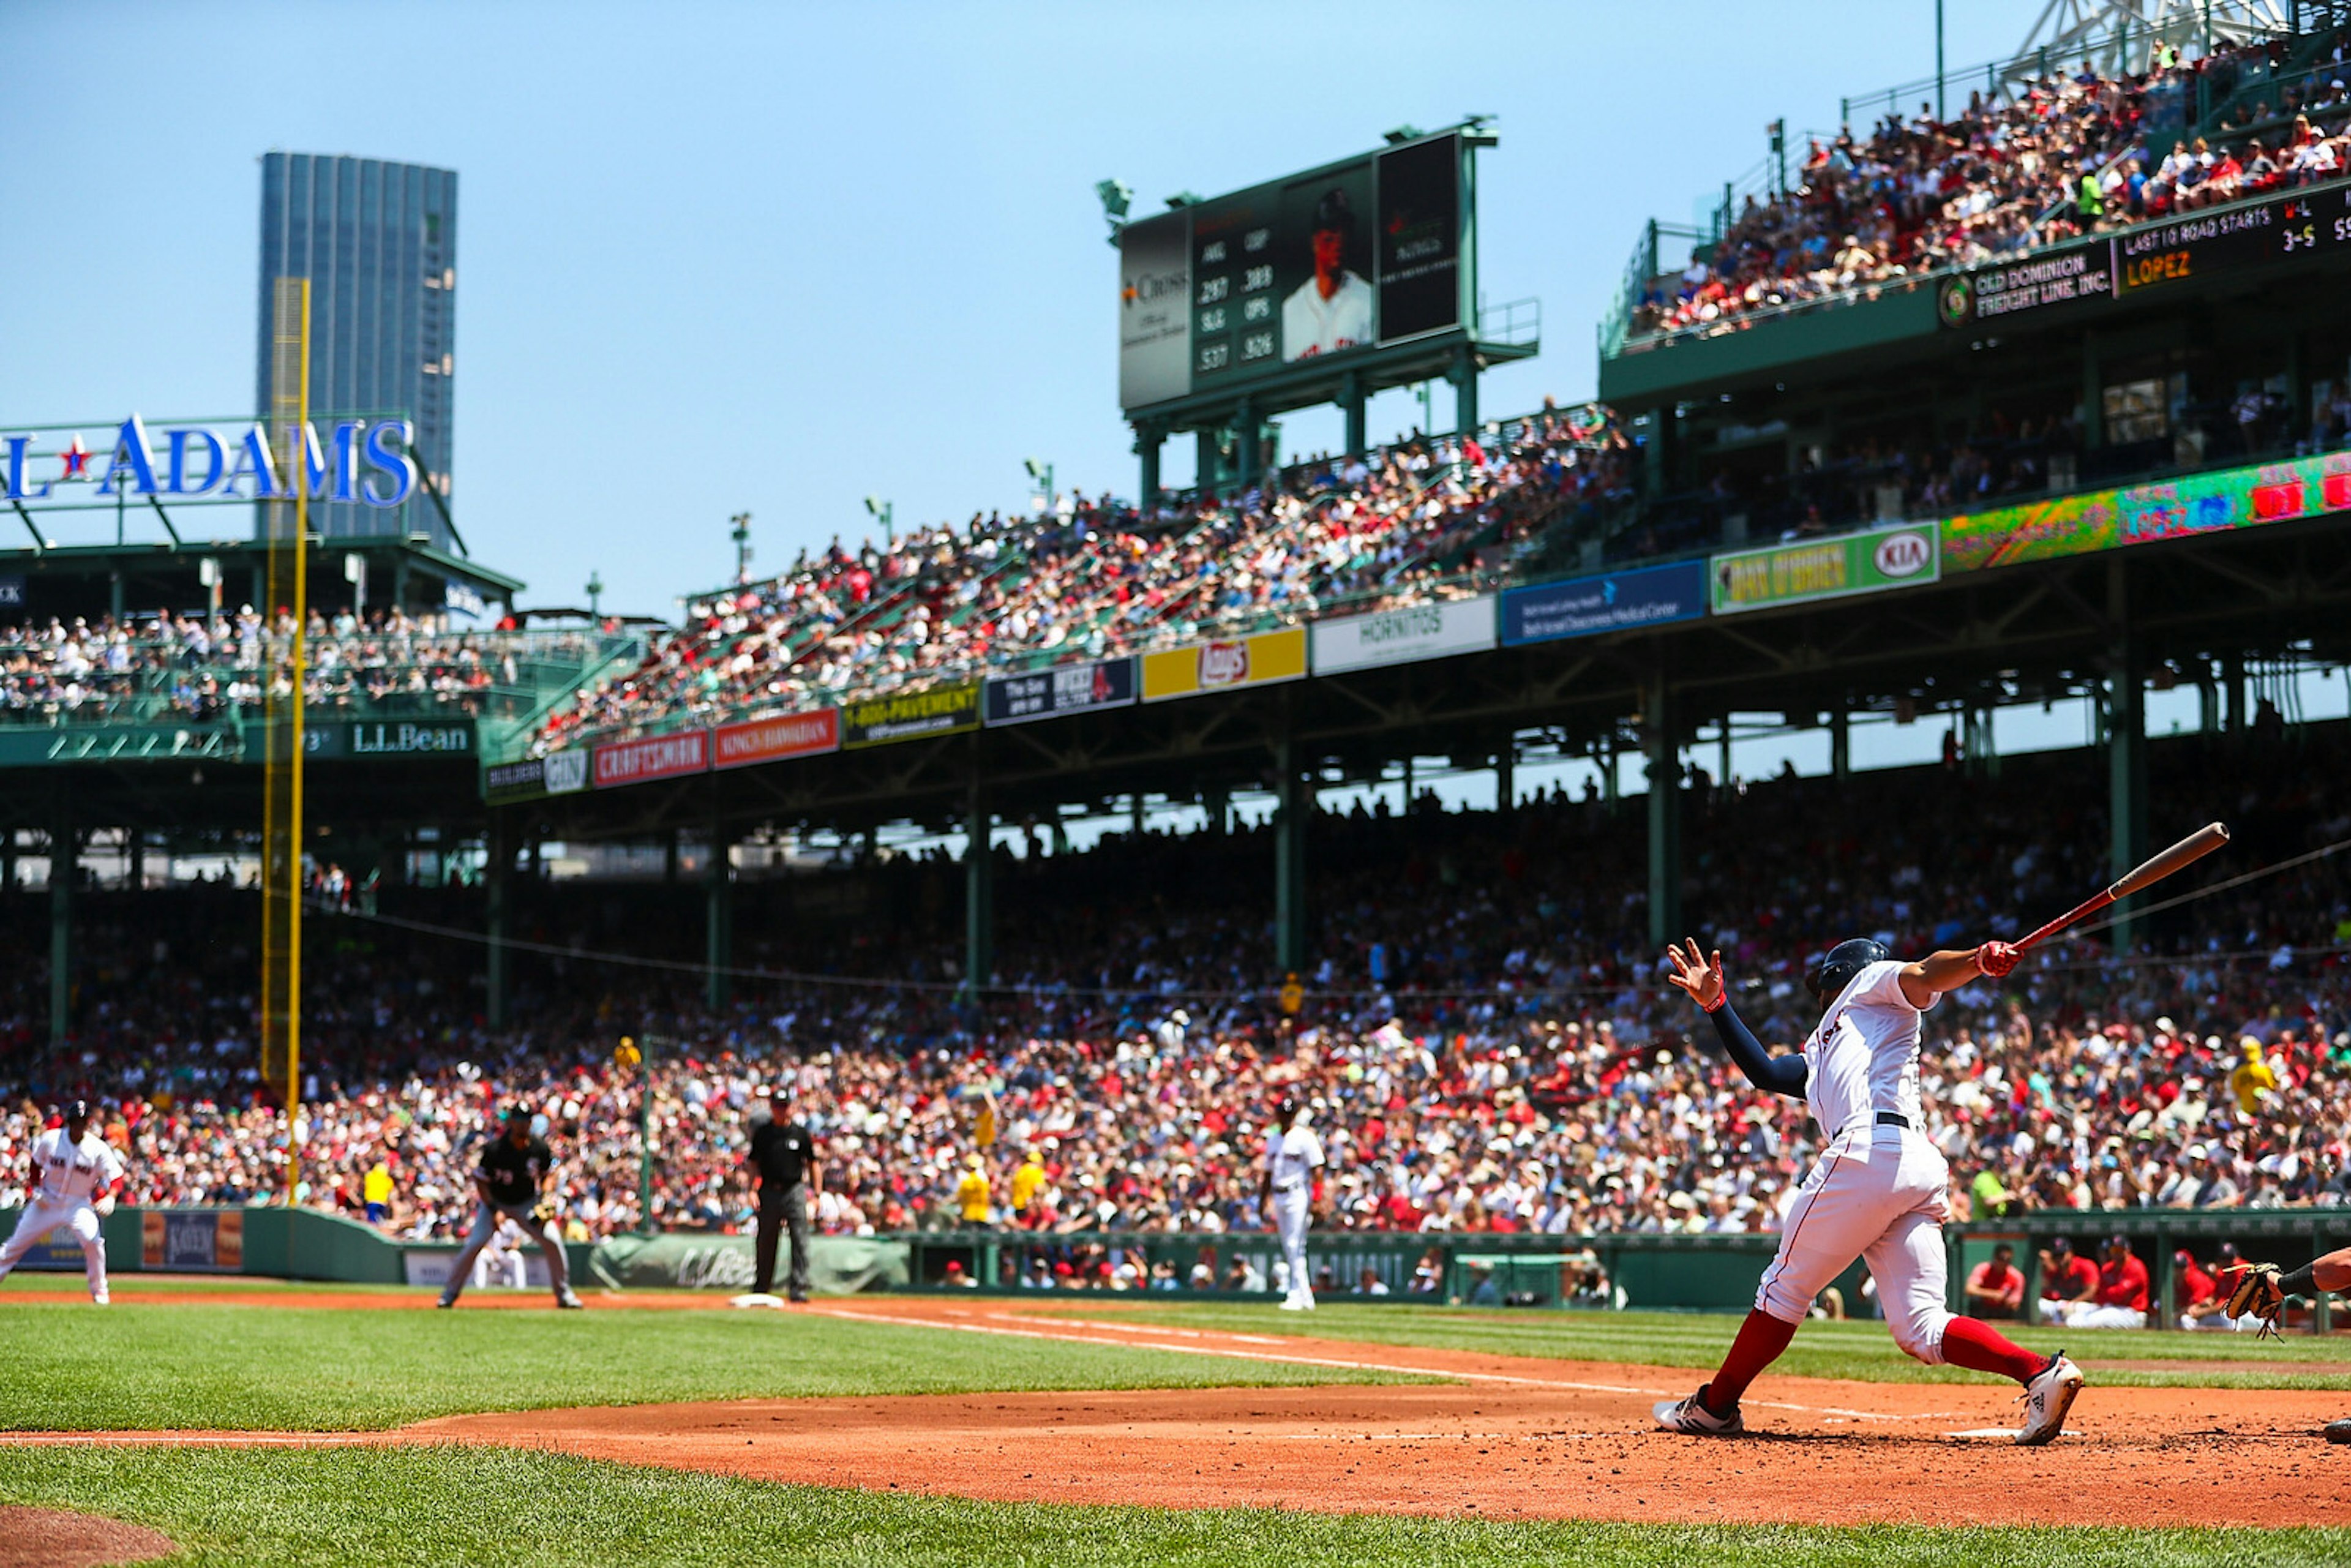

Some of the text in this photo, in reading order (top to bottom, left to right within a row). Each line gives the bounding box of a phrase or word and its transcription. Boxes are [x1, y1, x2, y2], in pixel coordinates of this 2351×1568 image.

[2124, 235, 2158, 255] LAST
[2219, 206, 2272, 235] STARTS
[2282, 222, 2316, 253] 3-5
[1975, 252, 2087, 295] OLD DOMINION
[2126, 250, 2192, 287] LOPEZ
[1976, 285, 2040, 318] FREIGHT
[94, 411, 418, 509] ADAMS
[1731, 541, 1847, 602] DAN O'BRIEN
[1884, 541, 1923, 568] KIA
[1359, 609, 1444, 646] HORNITOS
[1005, 680, 1025, 698] The
[353, 722, 468, 753] L.L.Bean
[490, 763, 542, 787] BUILDERS
[598, 735, 703, 779] CRAFTSMAN
